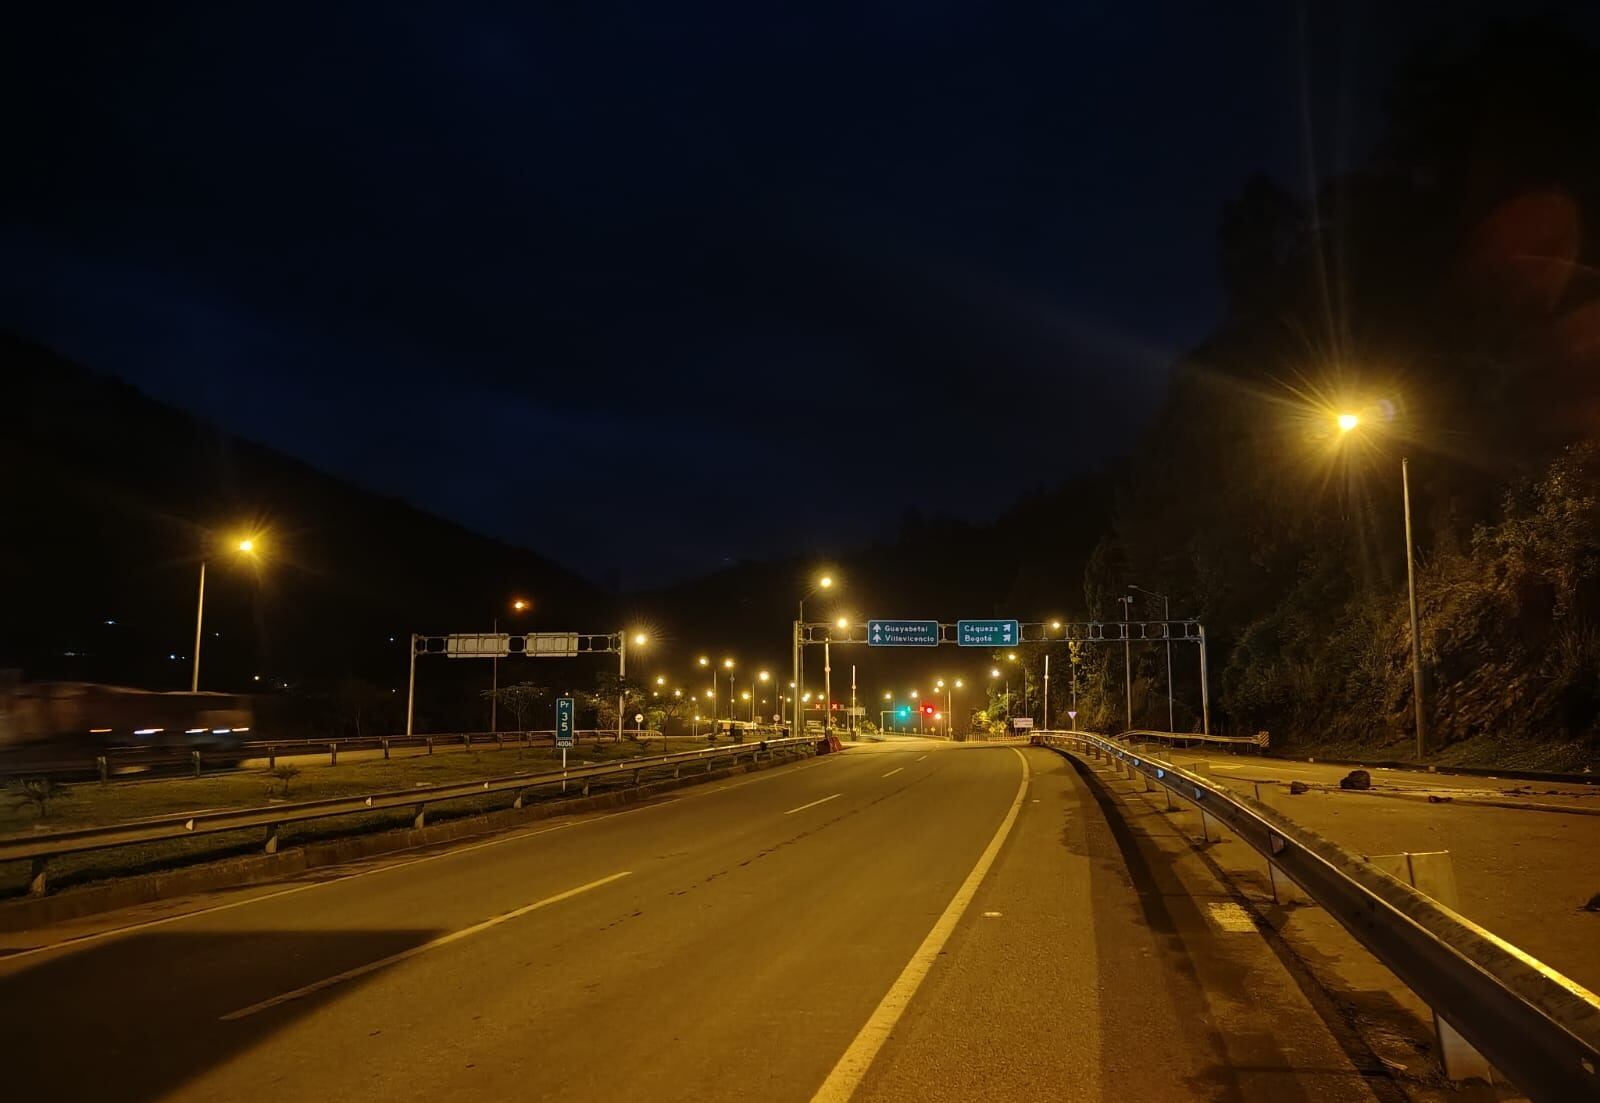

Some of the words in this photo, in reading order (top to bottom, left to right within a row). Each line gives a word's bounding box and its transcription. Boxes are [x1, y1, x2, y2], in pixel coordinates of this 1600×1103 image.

[884, 625, 928, 633] Guayabetal
[964, 624, 999, 634] Cáqueza
[884, 634, 935, 642] Villavicencio
[964, 634, 993, 643] Bogotá
